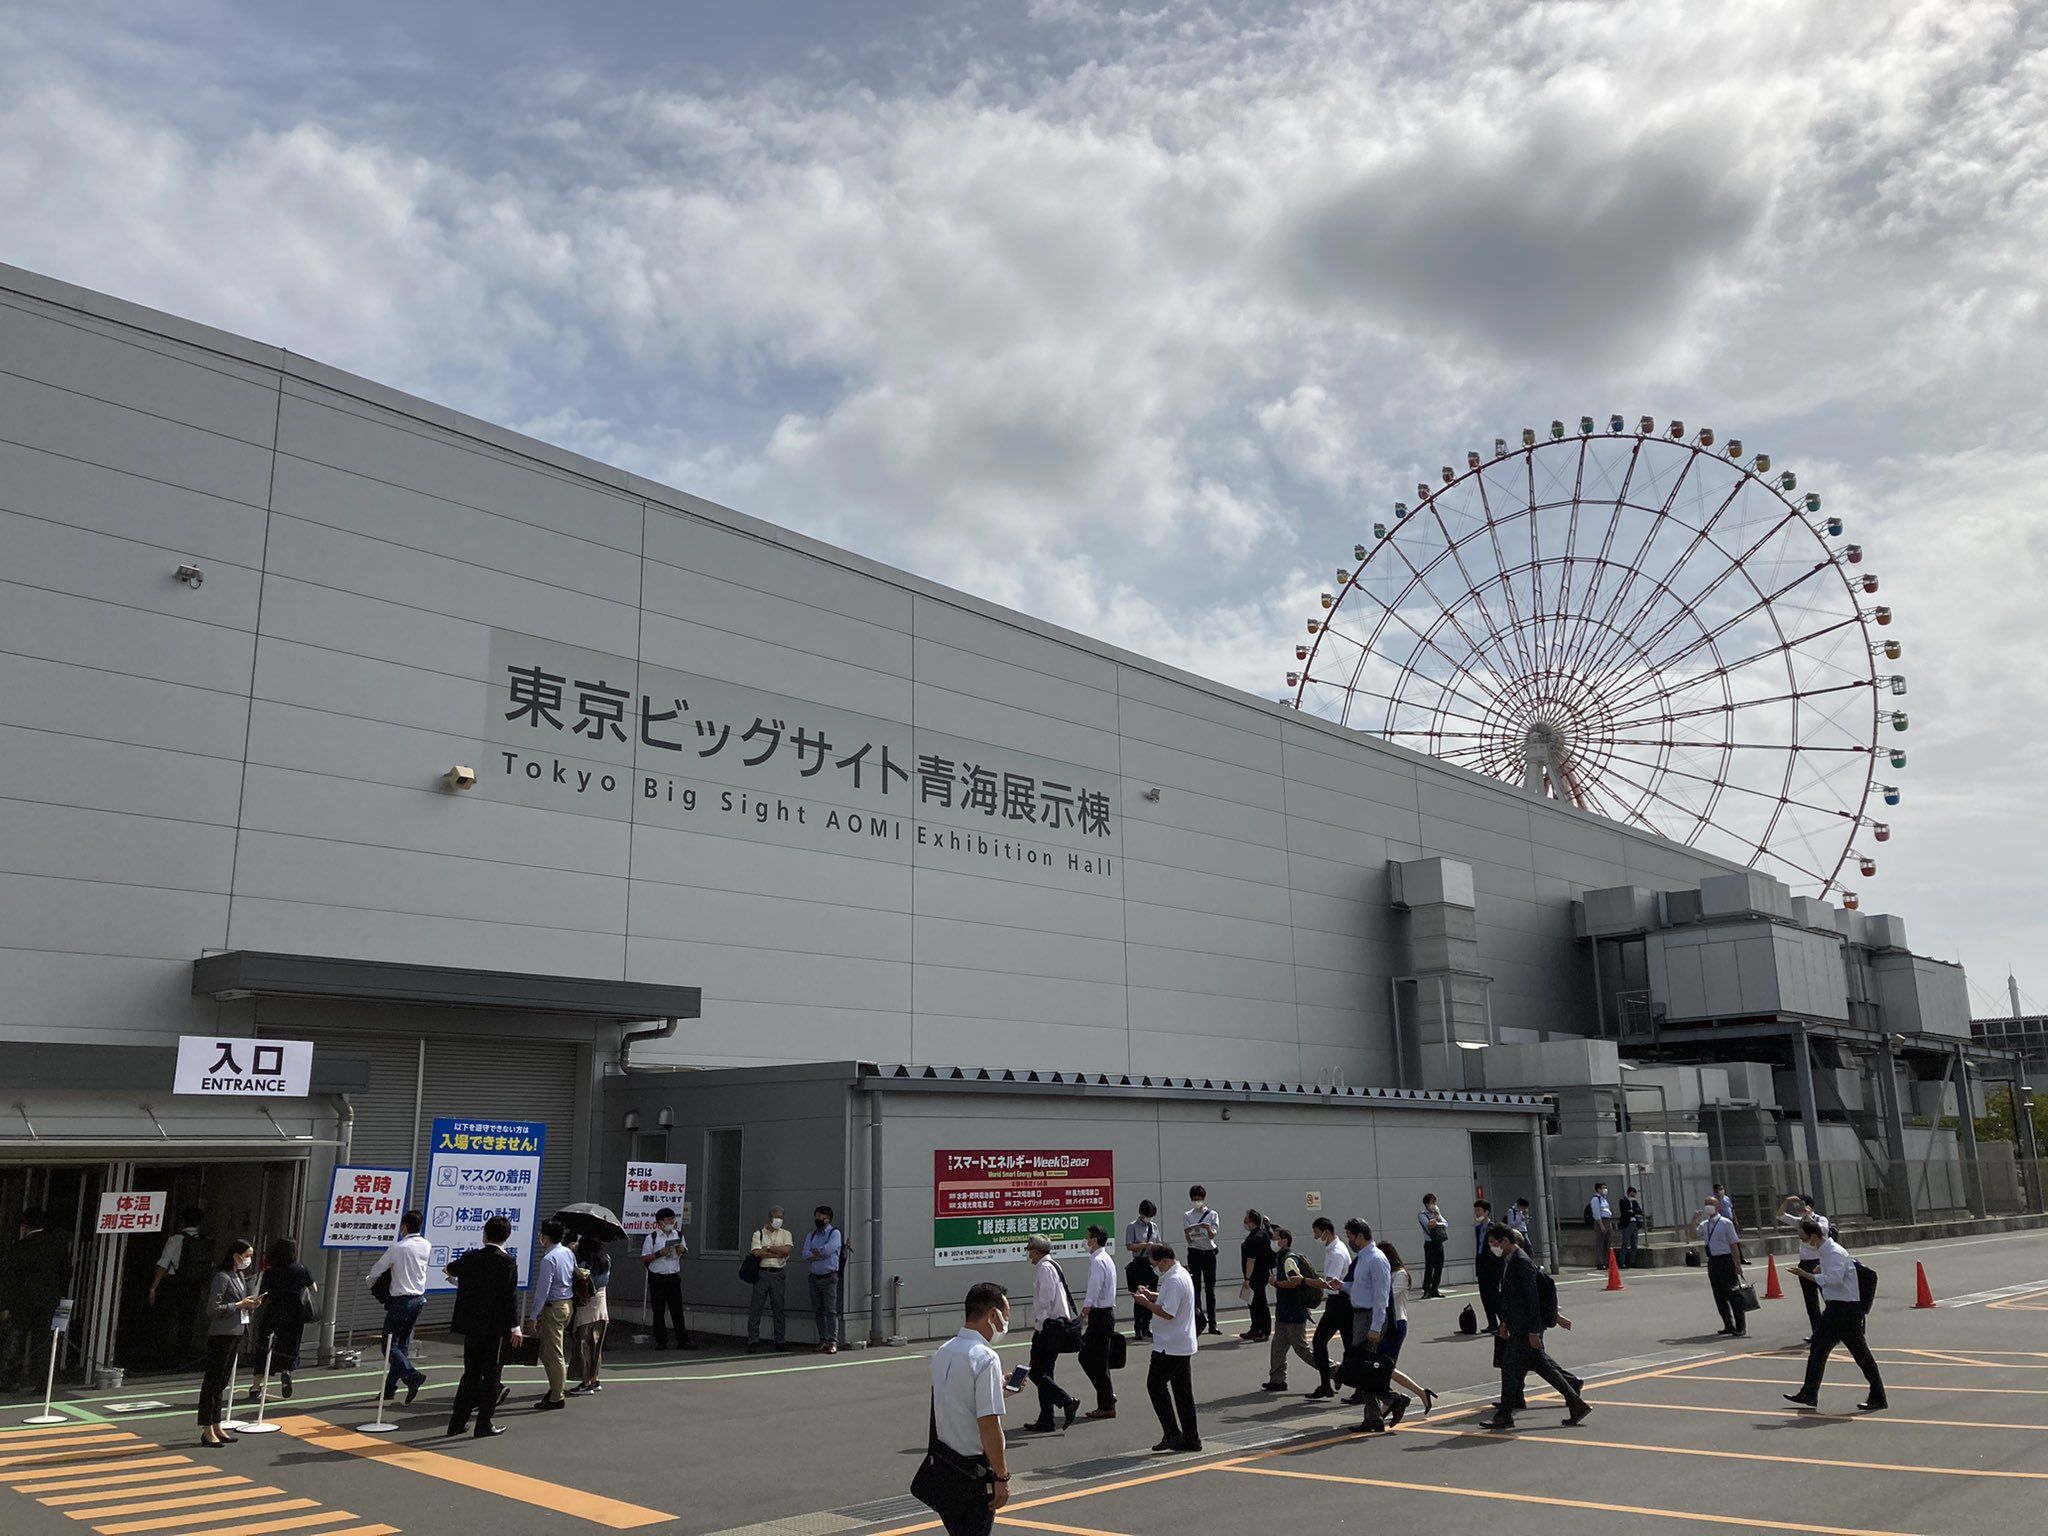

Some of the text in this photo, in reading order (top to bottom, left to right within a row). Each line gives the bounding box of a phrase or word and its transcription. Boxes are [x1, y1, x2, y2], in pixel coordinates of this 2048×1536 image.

[505, 665, 1111, 837] 東京ビッグサイト青海展示棟
[502, 752, 1111, 877] Tokyo Big Sight AOMI Exhibition Hall
[208, 1042, 284, 1075] 入口
[201, 1077, 286, 1092] ENTRANCE
[439, 1133, 538, 1152] 入場できません!
[461, 1169, 531, 1184] マスクの着用
[628, 1167, 652, 1177] 本日は
[353, 1174, 392, 1194] 常時
[627, 1179, 685, 1193] 午後6時まで
[117, 1196, 151, 1211] 体温
[334, 1195, 401, 1215] 換気中!
[100, 1213, 159, 1229] 測定中!
[623, 1221, 642, 1230] until
